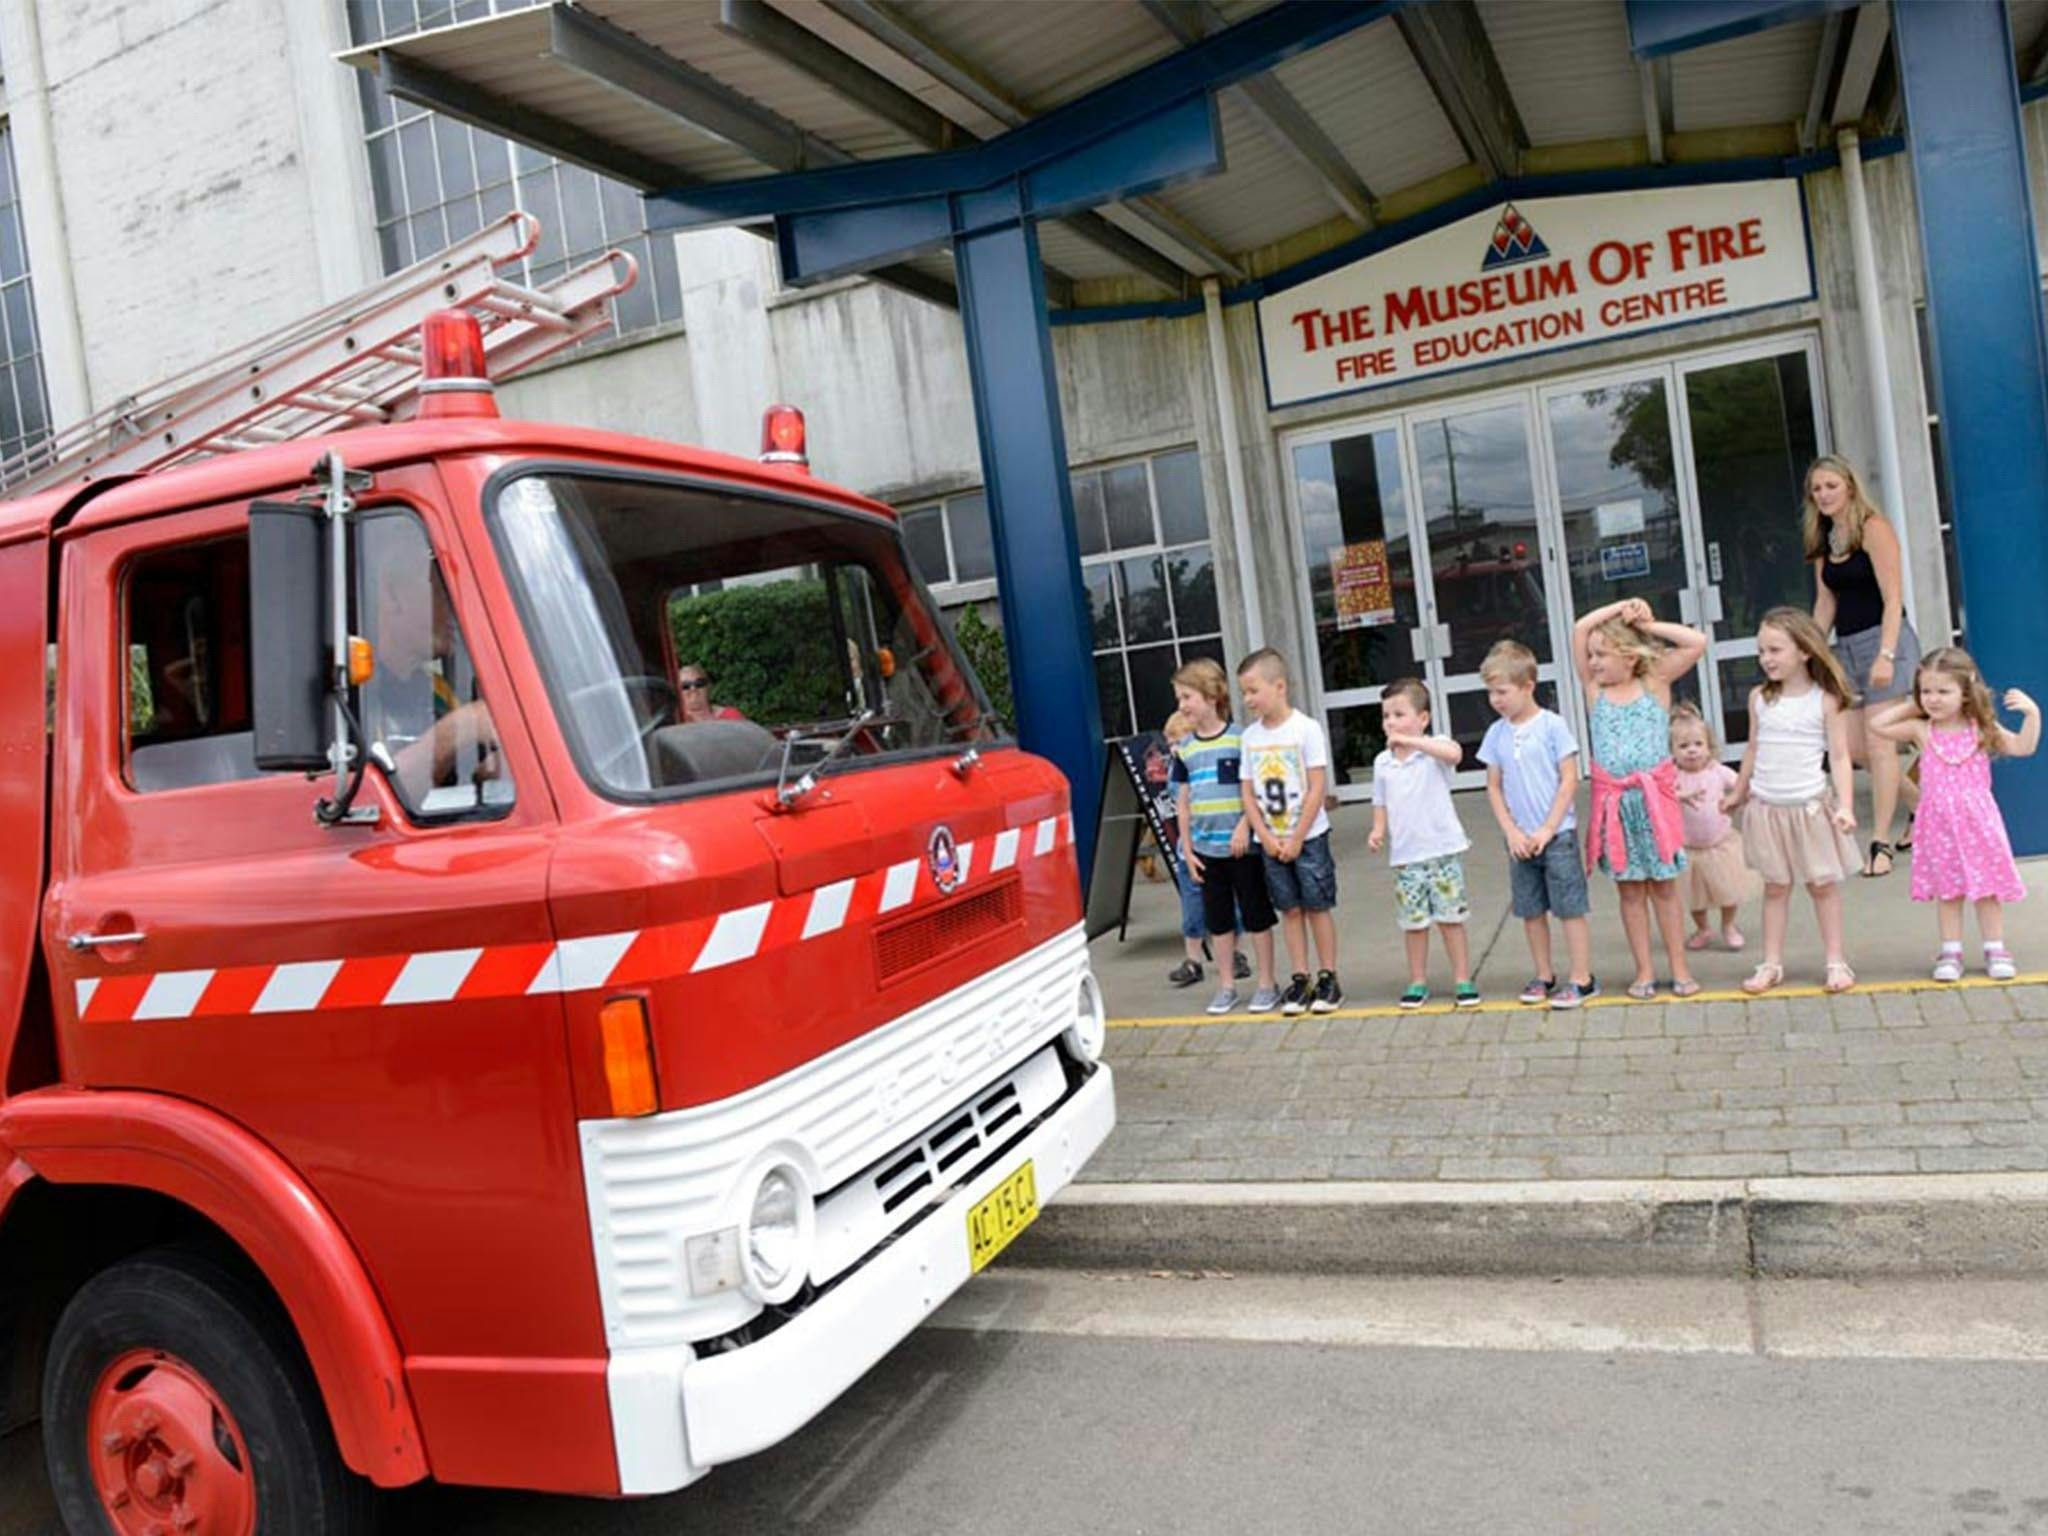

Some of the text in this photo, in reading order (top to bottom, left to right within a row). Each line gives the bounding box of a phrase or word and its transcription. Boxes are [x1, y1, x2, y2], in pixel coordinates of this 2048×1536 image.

[1292, 217, 1767, 352] THE MUSEUM OF FIRE
[1335, 277, 1728, 382] FIRE EDUCATION CENTRE
[1265, 777, 1287, 815] 9
